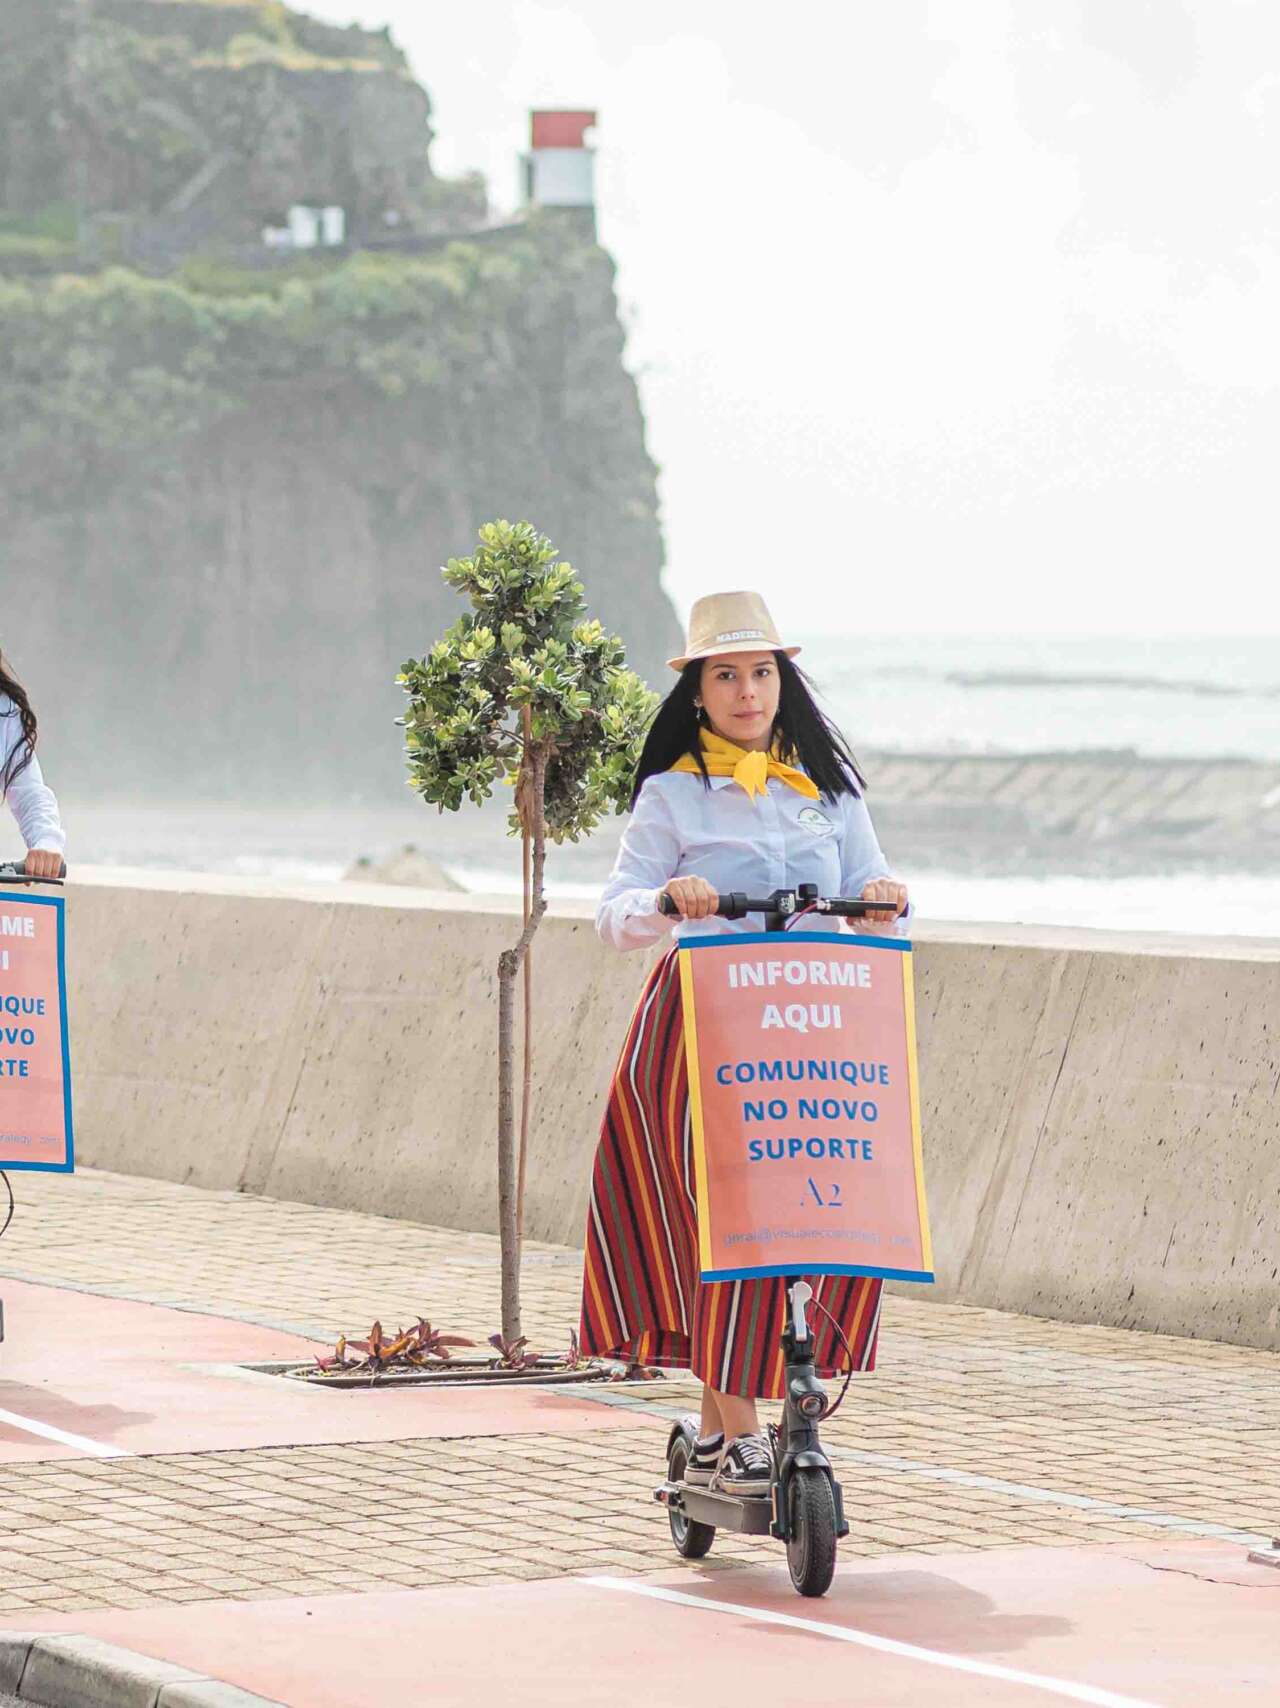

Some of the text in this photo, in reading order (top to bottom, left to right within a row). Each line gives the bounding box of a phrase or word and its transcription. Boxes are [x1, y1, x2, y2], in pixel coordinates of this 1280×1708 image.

[728, 960, 872, 989] INFORME
[761, 1004, 842, 1033] AQUI
[716, 1060, 890, 1086] COMUNIQUE
[743, 1098, 879, 1123] NO NOVO
[748, 1138, 873, 1161] SUPORTE
